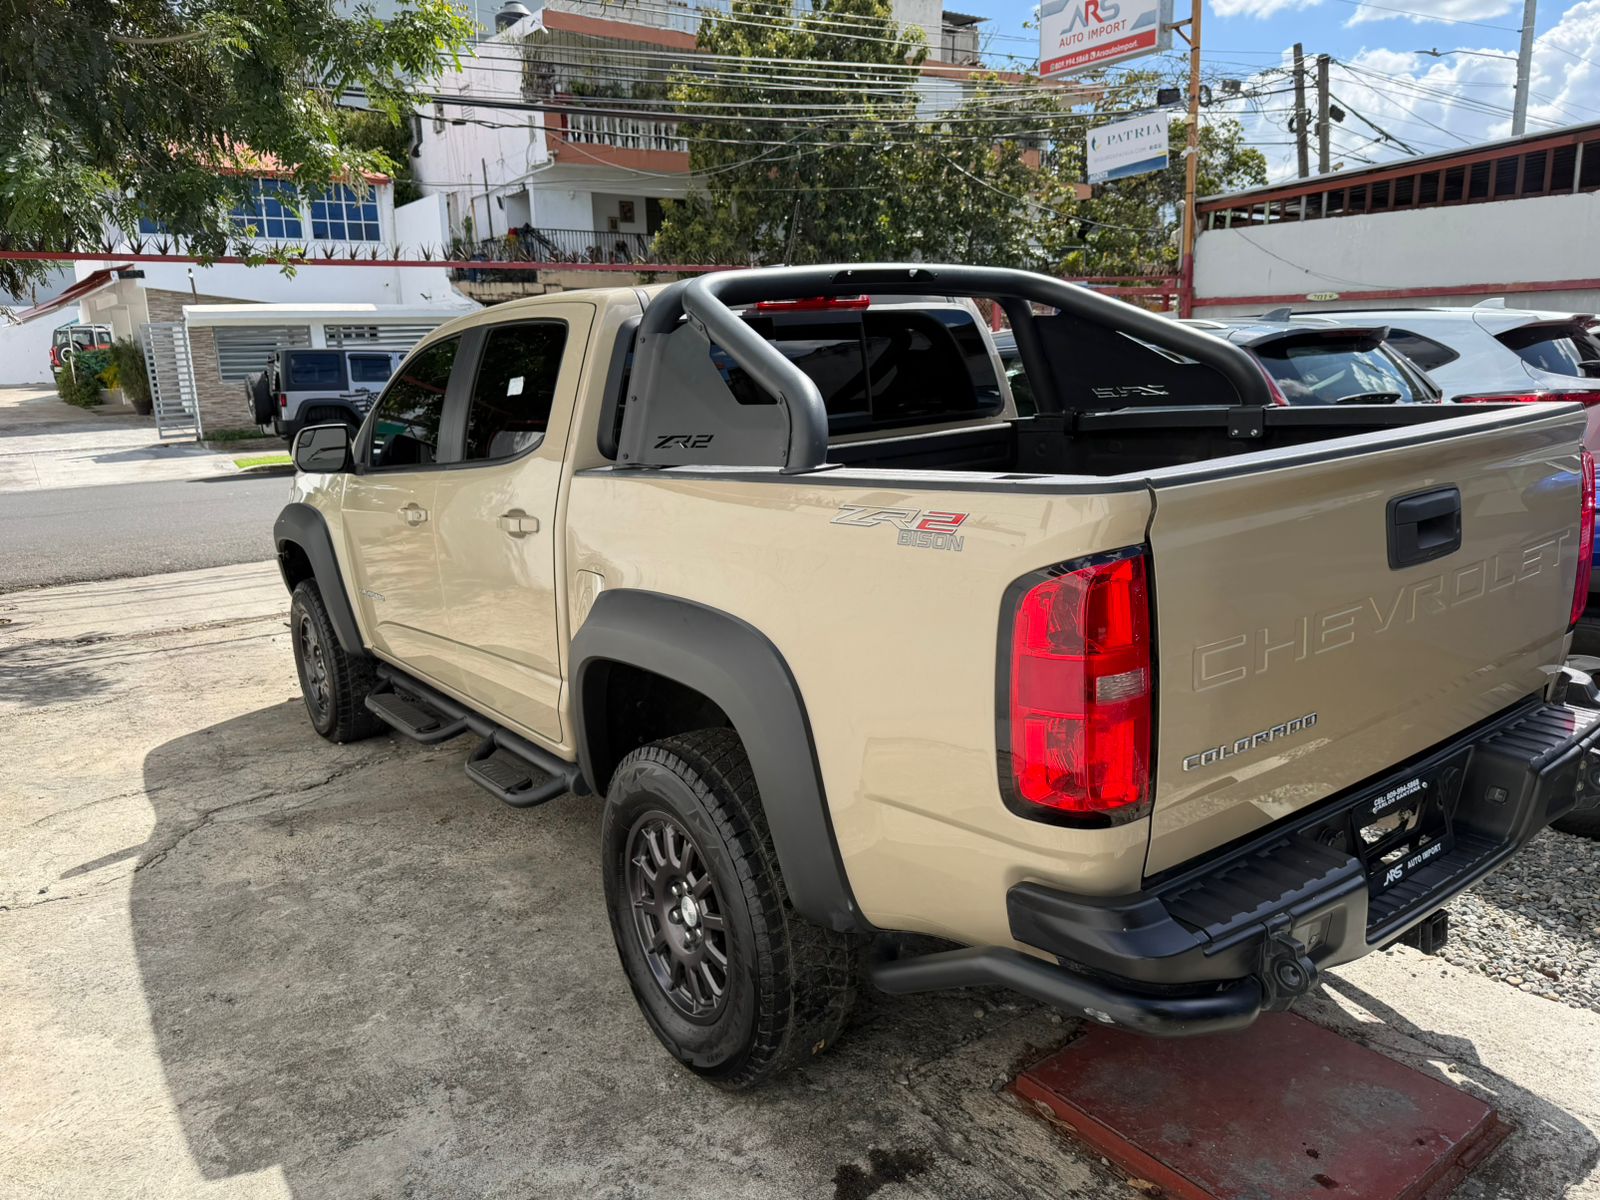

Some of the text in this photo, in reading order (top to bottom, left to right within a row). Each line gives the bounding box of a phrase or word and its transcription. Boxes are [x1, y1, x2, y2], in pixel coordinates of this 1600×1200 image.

[1060, 0, 1120, 35] ARS
[1058, 19, 1127, 48] AUTO IMPORT
[1106, 123, 1162, 145] PATRIA
[654, 434, 714, 449] ZR2
[830, 504, 970, 535] ZR2
[897, 529, 965, 552] BISON
[1192, 530, 1571, 692] CHEVROLET
[1182, 711, 1318, 772] COLORADO
[1407, 855, 1421, 869] AUTO
[1421, 842, 1441, 861] IMPORT
